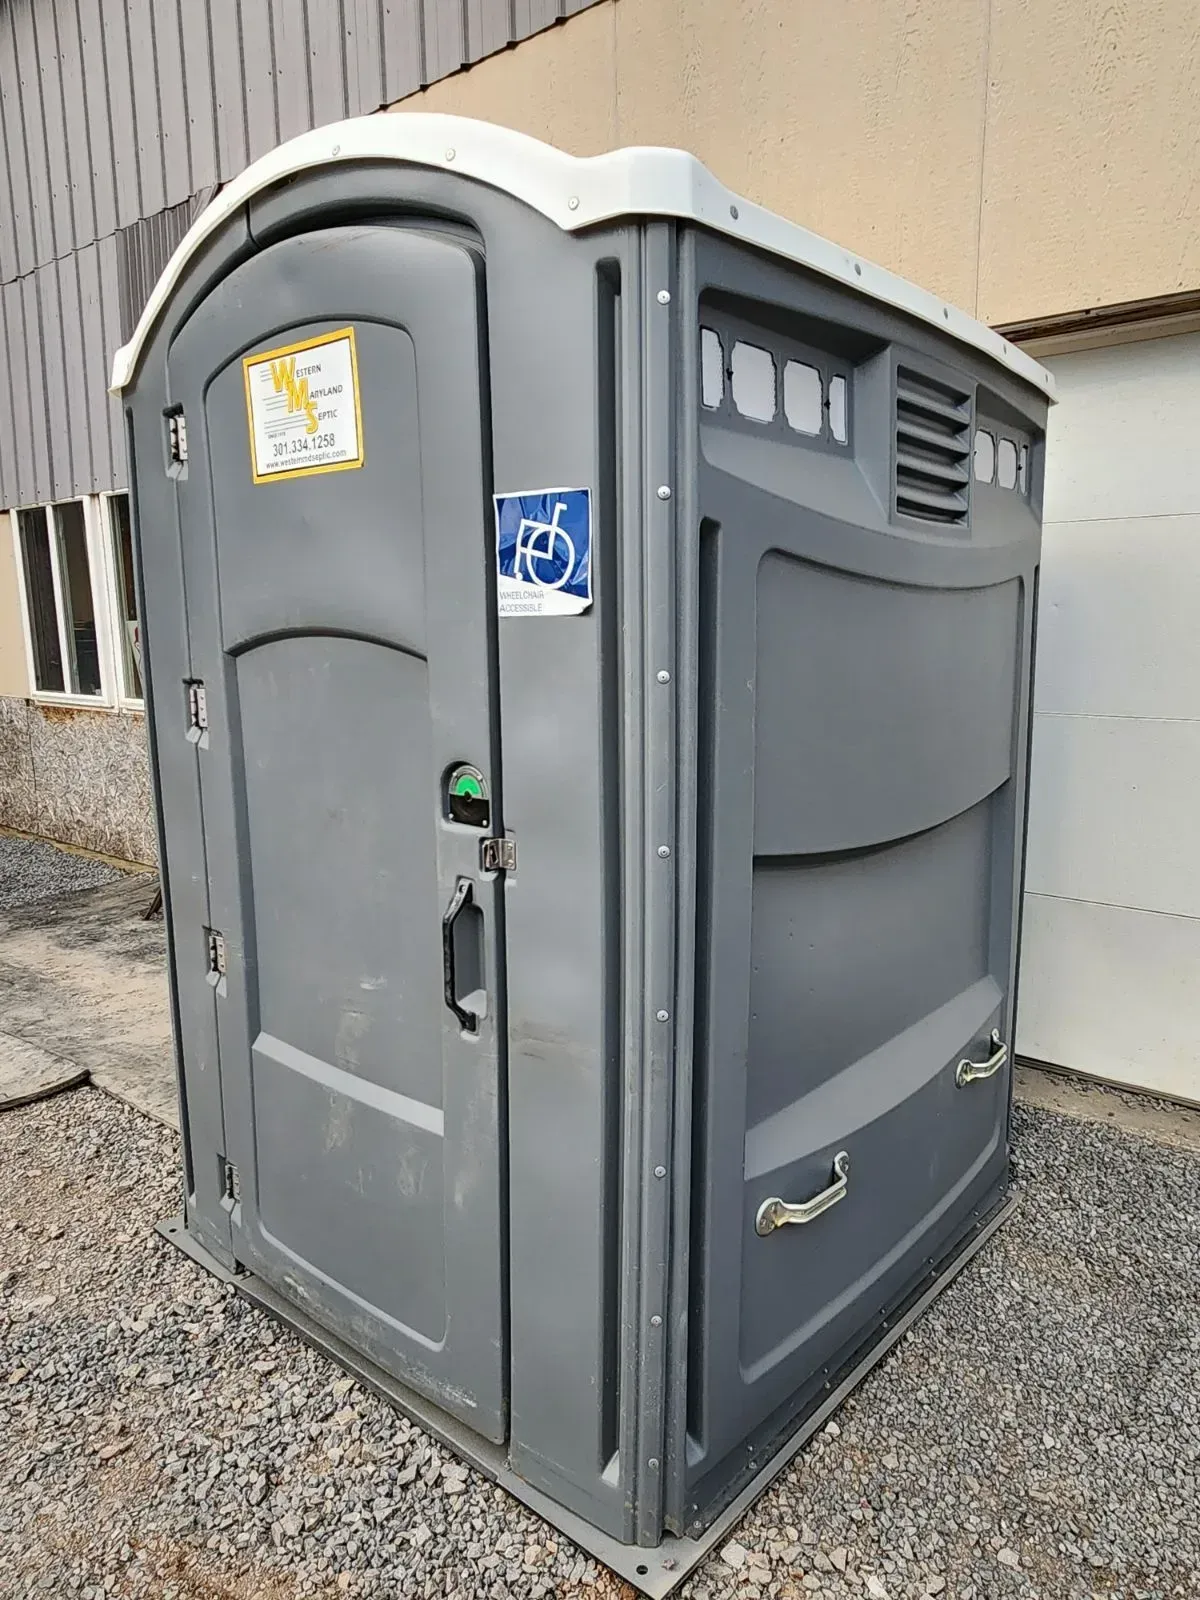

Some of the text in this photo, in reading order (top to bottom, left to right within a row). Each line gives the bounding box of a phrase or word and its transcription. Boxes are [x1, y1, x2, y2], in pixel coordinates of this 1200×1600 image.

[271, 356, 322, 392] WESTERN
[287, 377, 343, 413] MARYLAND
[305, 401, 338, 434] SEPTIC
[273, 433, 335, 457] 301.334.1258
[499, 590, 545, 600] WHEELCHAIR
[499, 603, 543, 613] ACCESSIBLE
